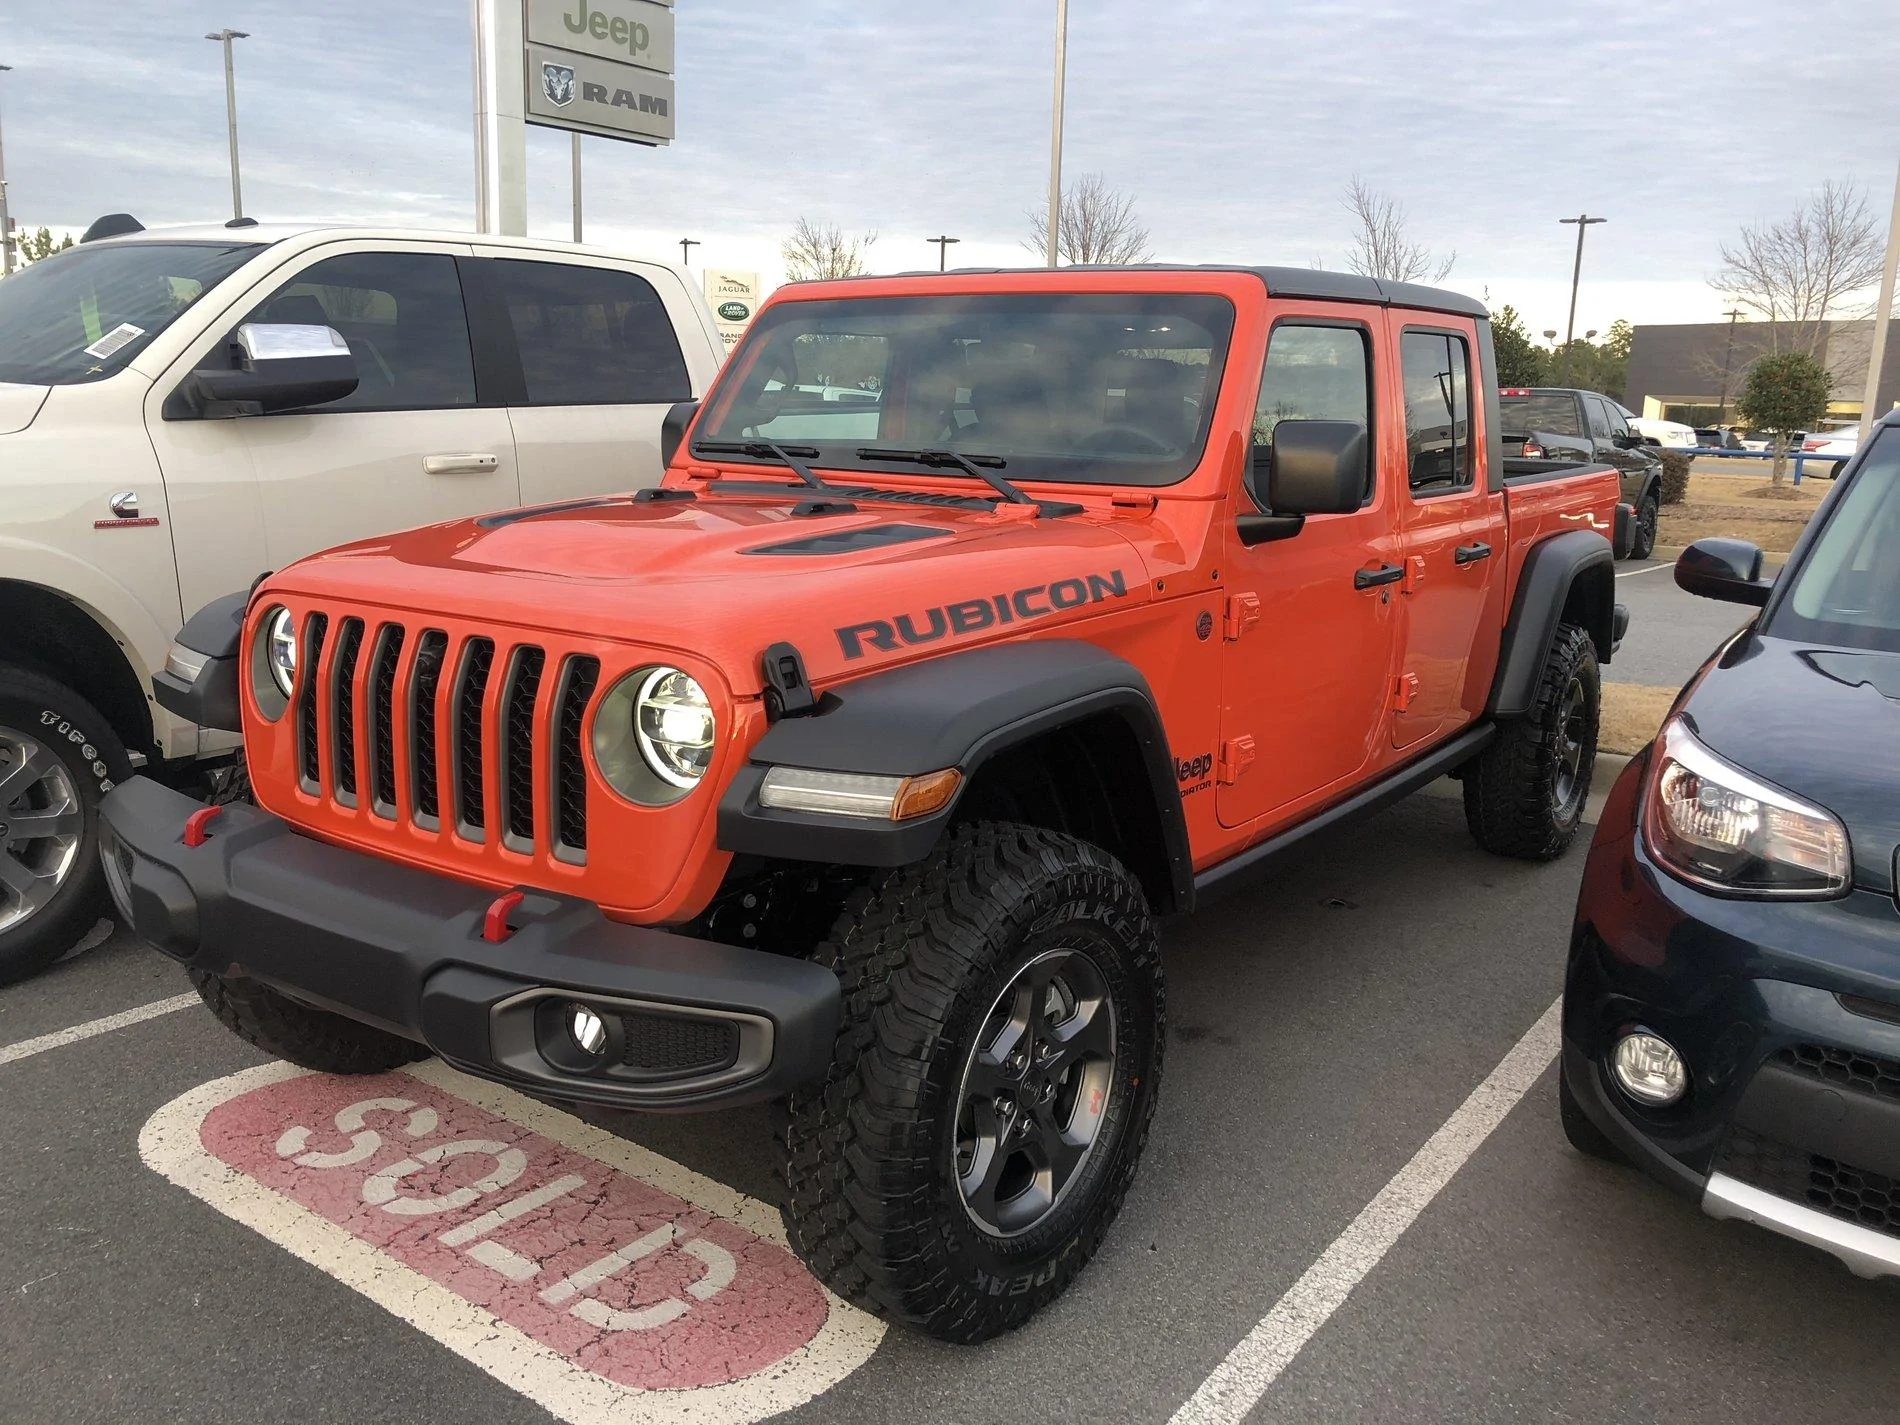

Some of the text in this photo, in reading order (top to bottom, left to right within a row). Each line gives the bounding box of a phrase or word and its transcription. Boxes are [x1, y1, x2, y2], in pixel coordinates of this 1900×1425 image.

[563, 0, 649, 56] Jeep
[582, 81, 668, 117] RAM
[719, 285, 750, 293] JAGUAR
[833, 569, 1128, 660] RUBICON
[40, 710, 115, 792] Firest
[1180, 780, 1211, 798] DIATOR
[275, 1097, 737, 1331] SOLD
